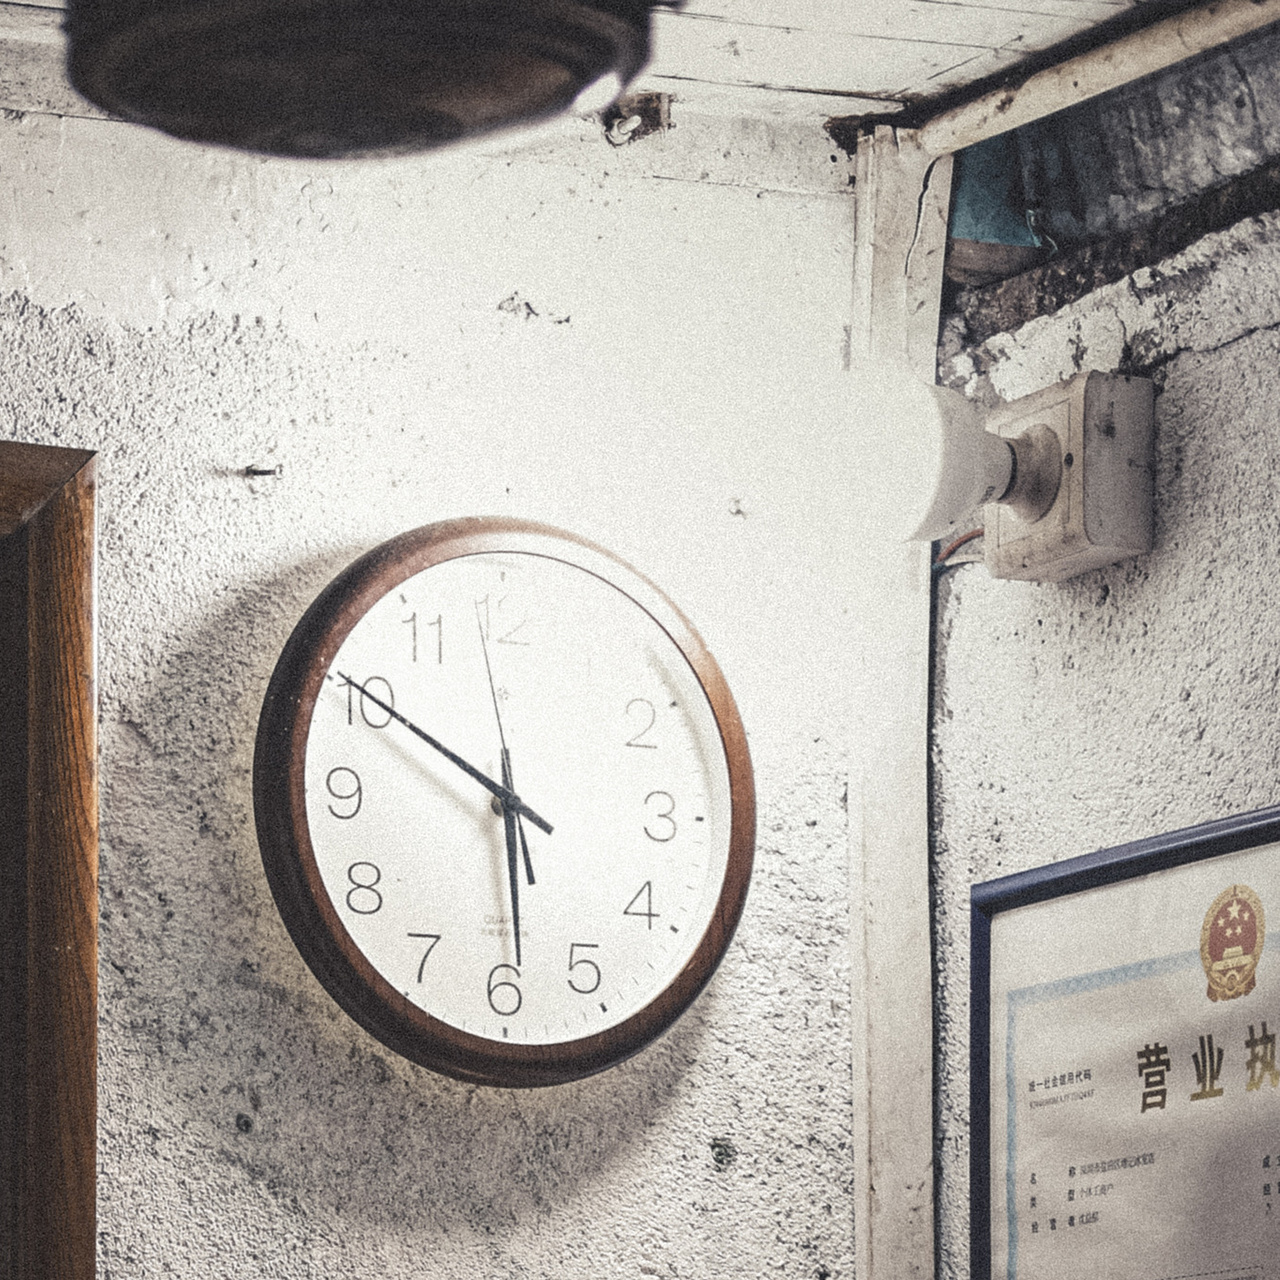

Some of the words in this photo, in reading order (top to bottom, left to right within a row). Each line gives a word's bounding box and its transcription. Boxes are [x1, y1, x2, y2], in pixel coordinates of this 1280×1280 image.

[402, 612, 443, 664] 11
[338, 675, 394, 729] 10
[625, 698, 658, 750] 2
[326, 767, 362, 819] 9
[644, 790, 677, 842] 3
[346, 861, 383, 914] 8
[623, 880, 661, 931] 4
[407, 932, 441, 984] 7
[567, 942, 601, 994] 5
[486, 963, 523, 1016] 6
